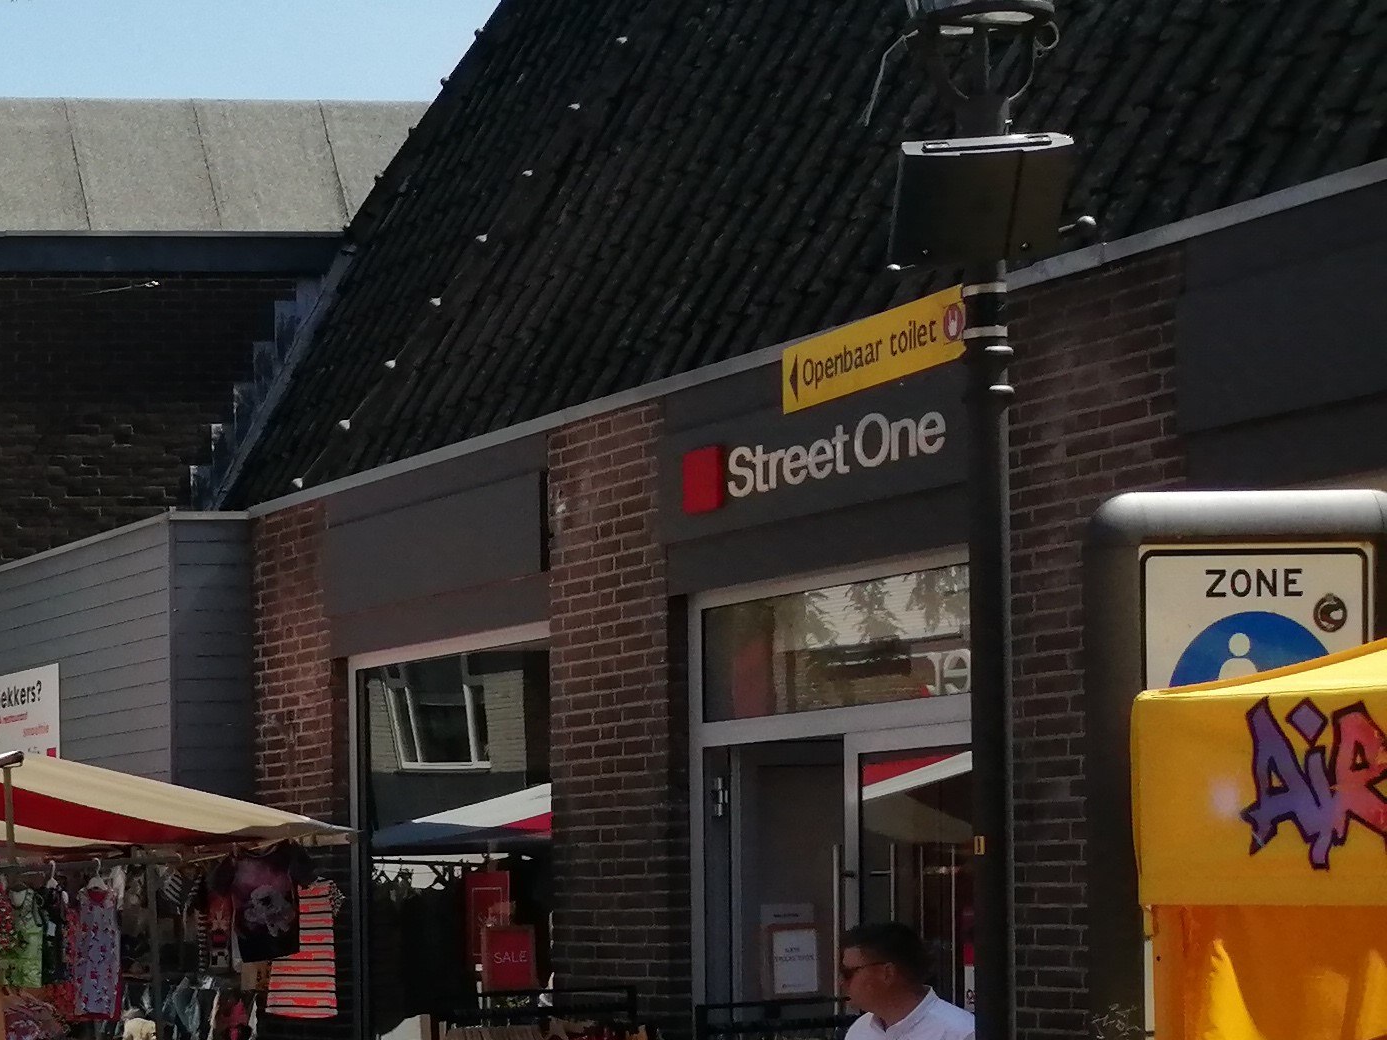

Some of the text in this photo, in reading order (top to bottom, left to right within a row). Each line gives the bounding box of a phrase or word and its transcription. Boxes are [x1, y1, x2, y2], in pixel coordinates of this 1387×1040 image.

[802, 319, 937, 389] Openbaar toilet
[1205, 568, 1304, 598] ZONE
[493, 951, 527, 964] SALE
